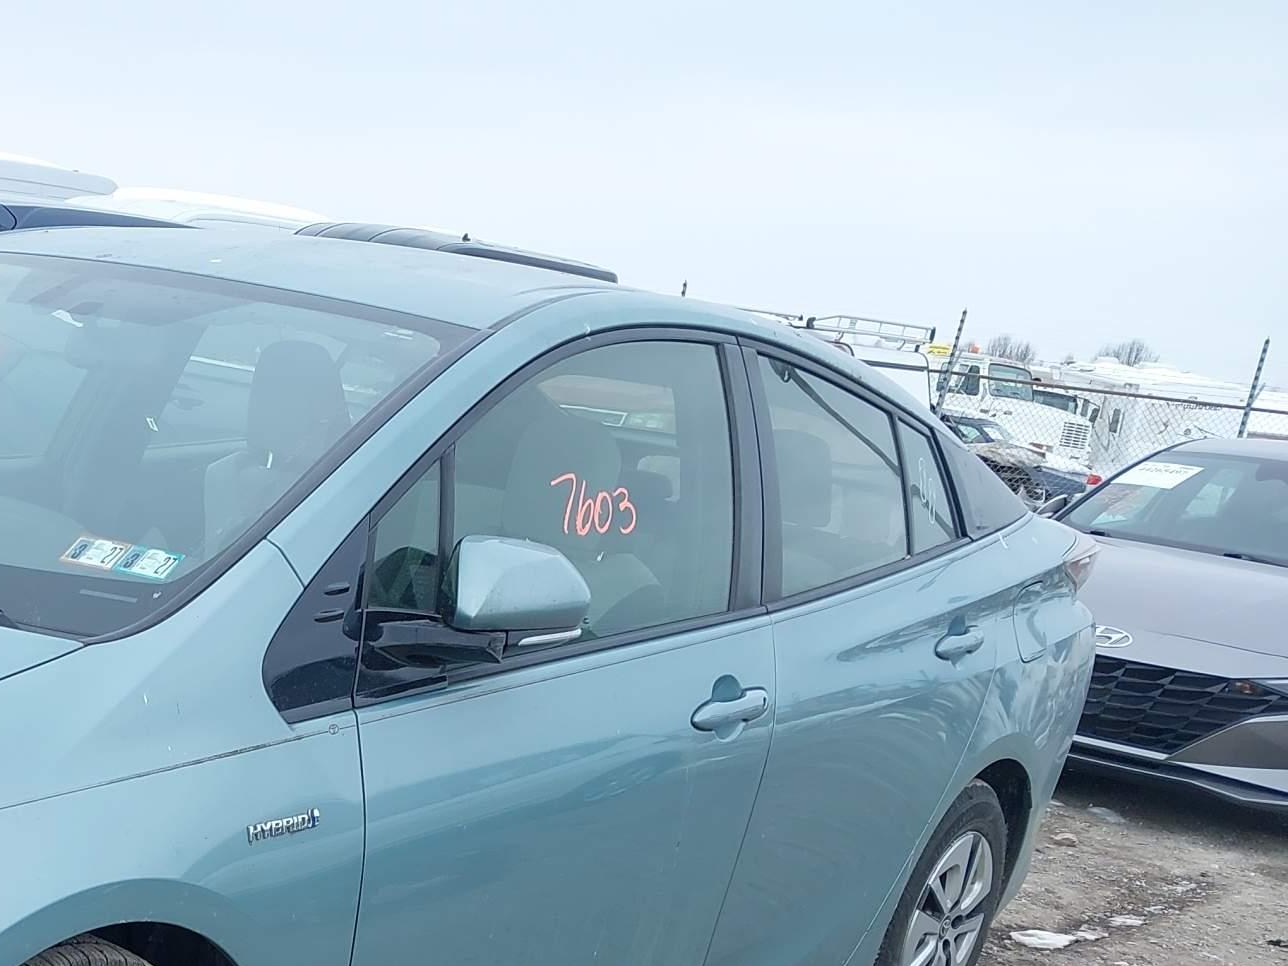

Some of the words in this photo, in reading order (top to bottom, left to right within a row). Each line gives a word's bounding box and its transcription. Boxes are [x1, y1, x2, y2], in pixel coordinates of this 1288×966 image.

[550, 472, 637, 536] 7603
[100, 546, 125, 566] 27
[154, 556, 178, 576] 27
[247, 813, 308, 845] HYBRID
